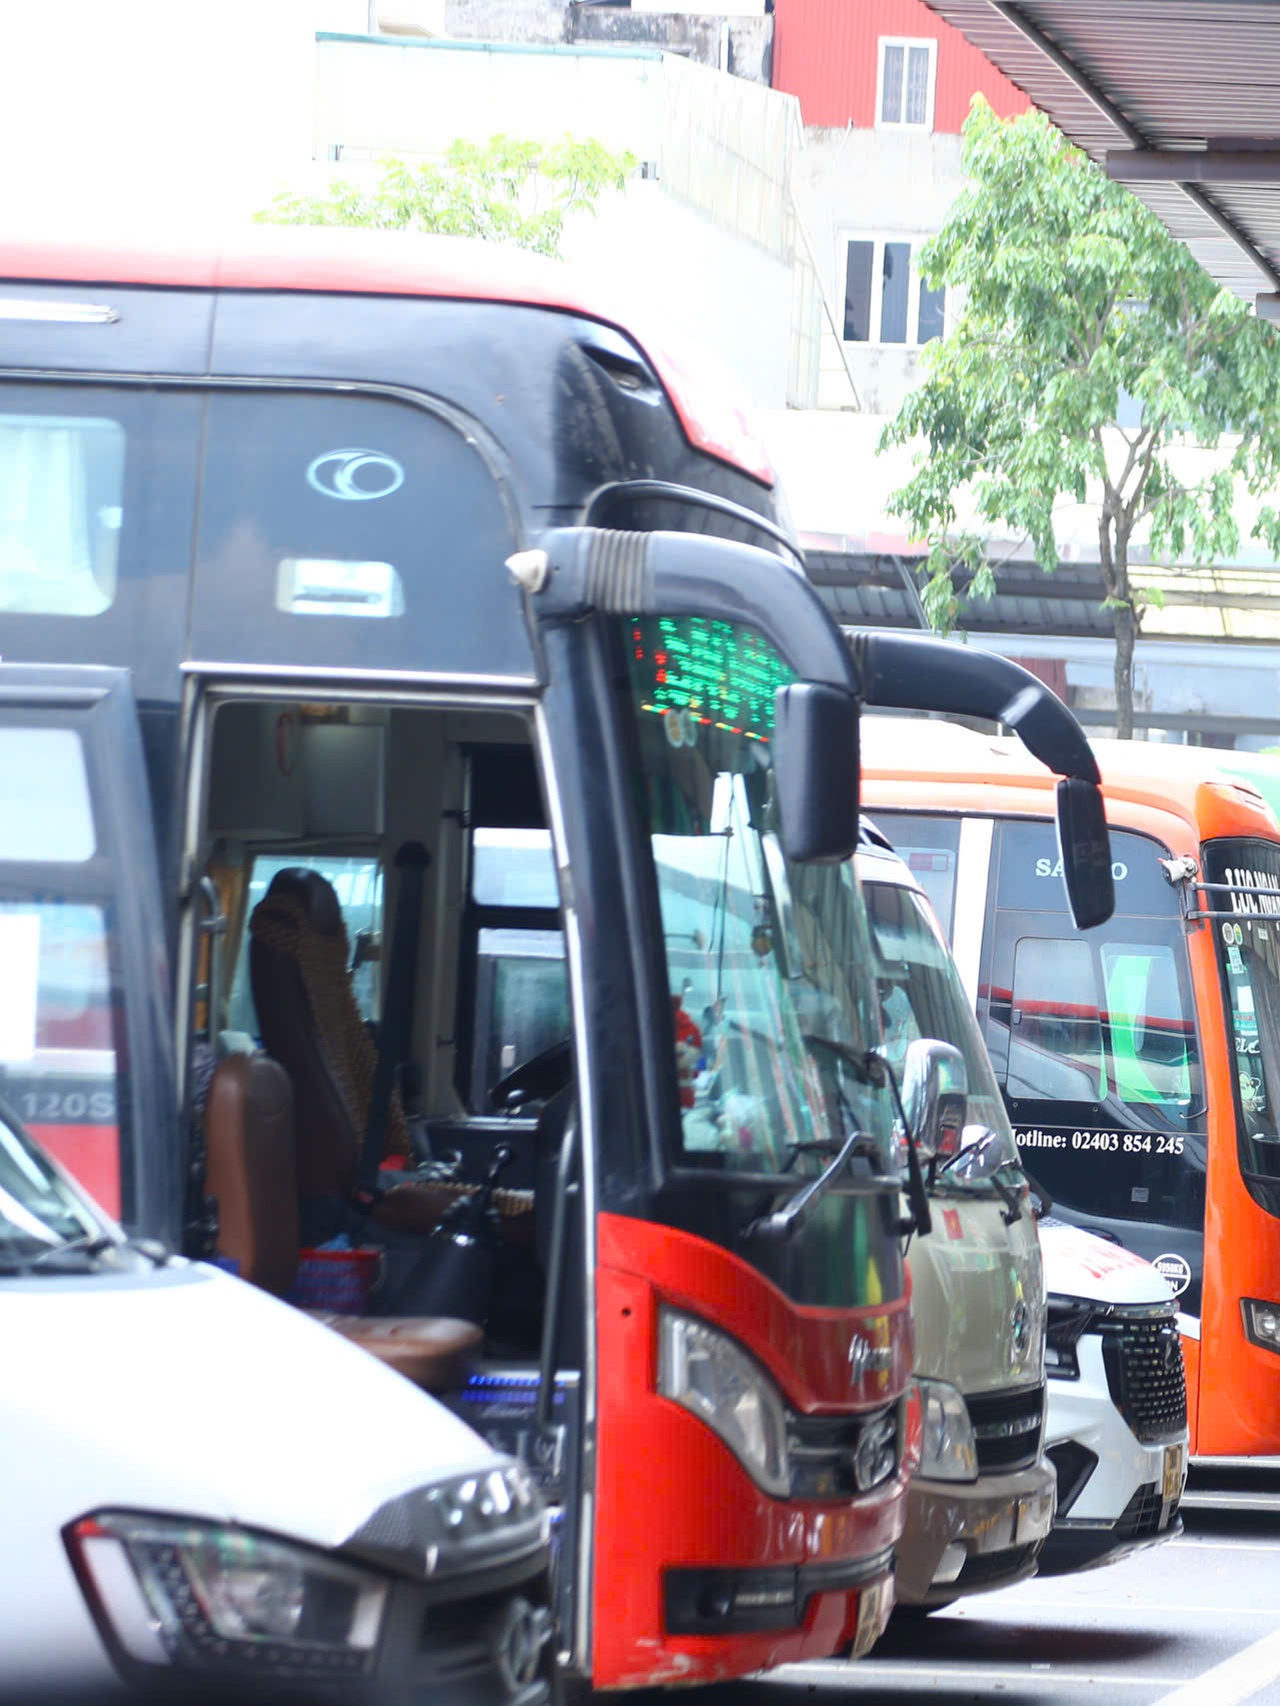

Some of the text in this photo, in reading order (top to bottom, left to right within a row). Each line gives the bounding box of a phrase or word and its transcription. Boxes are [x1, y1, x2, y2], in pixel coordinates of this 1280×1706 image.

[1035, 858, 1128, 881] SAO
[1072, 1131, 1119, 1151] 02403
[1123, 1134, 1152, 1153] 854
[1156, 1136, 1184, 1155] 245
